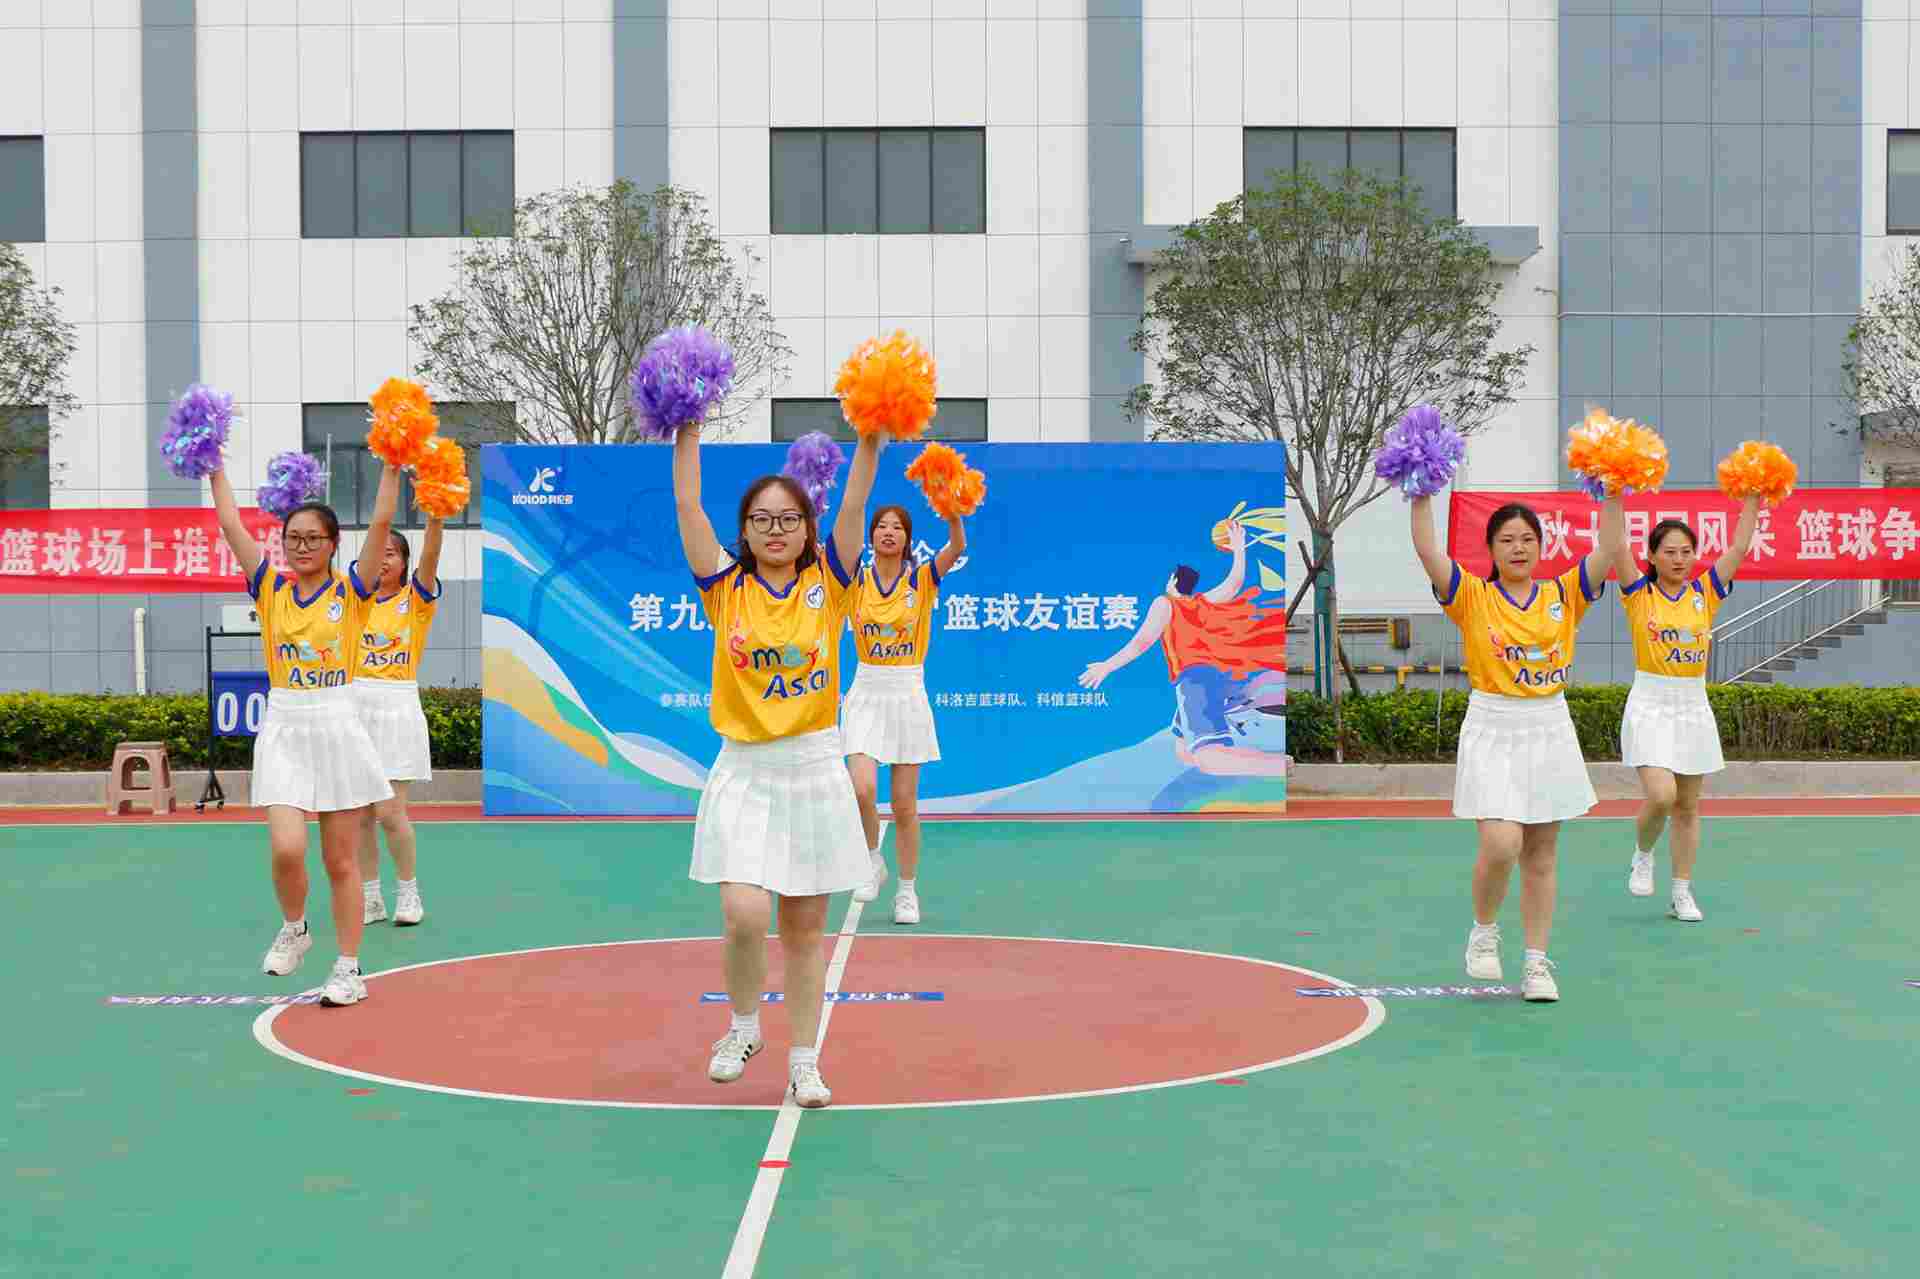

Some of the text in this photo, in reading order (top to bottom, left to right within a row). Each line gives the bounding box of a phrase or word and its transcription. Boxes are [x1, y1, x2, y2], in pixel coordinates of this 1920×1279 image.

[512, 495, 547, 504] KOLOD
[1796, 507, 1920, 560] 篮球争
[629, 593, 1140, 632] 第九 篮球友谊赛
[289, 666, 346, 688] Asian
[762, 668, 829, 699] Asia
